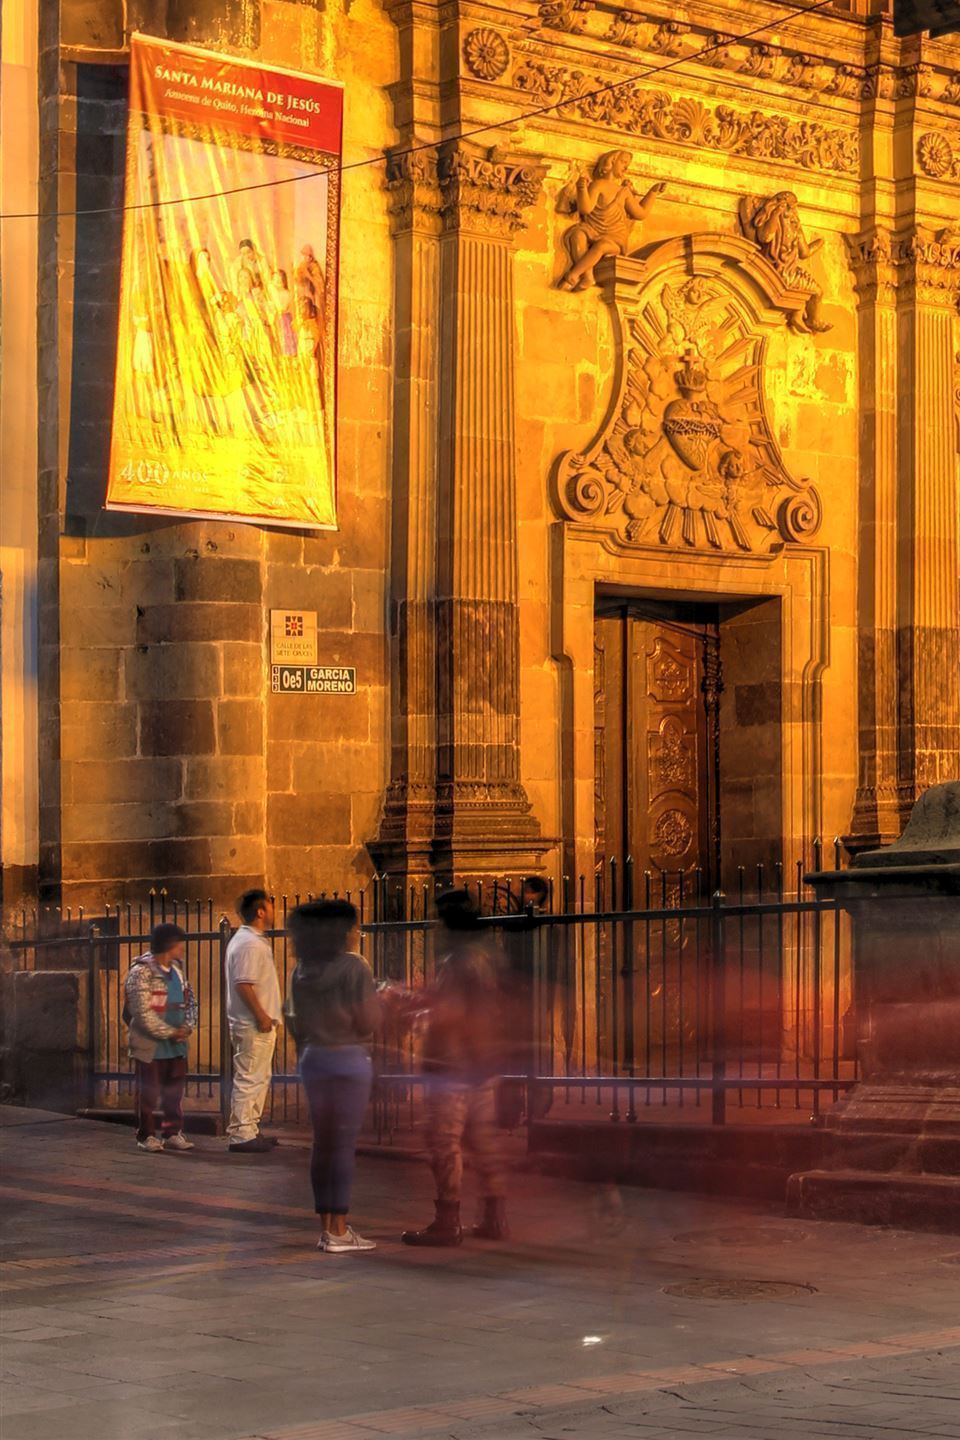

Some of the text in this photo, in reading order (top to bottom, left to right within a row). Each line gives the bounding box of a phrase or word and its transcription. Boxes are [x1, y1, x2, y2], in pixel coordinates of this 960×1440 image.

[154, 64, 321, 115] SANTA MARIANA DE JESÚS
[201, 96, 212, 107] de
[212, 98, 239, 113] Quito,
[274, 111, 310, 128] Nacional
[310, 669, 350, 680] GARCIA
[307, 681, 353, 692] MORENO
